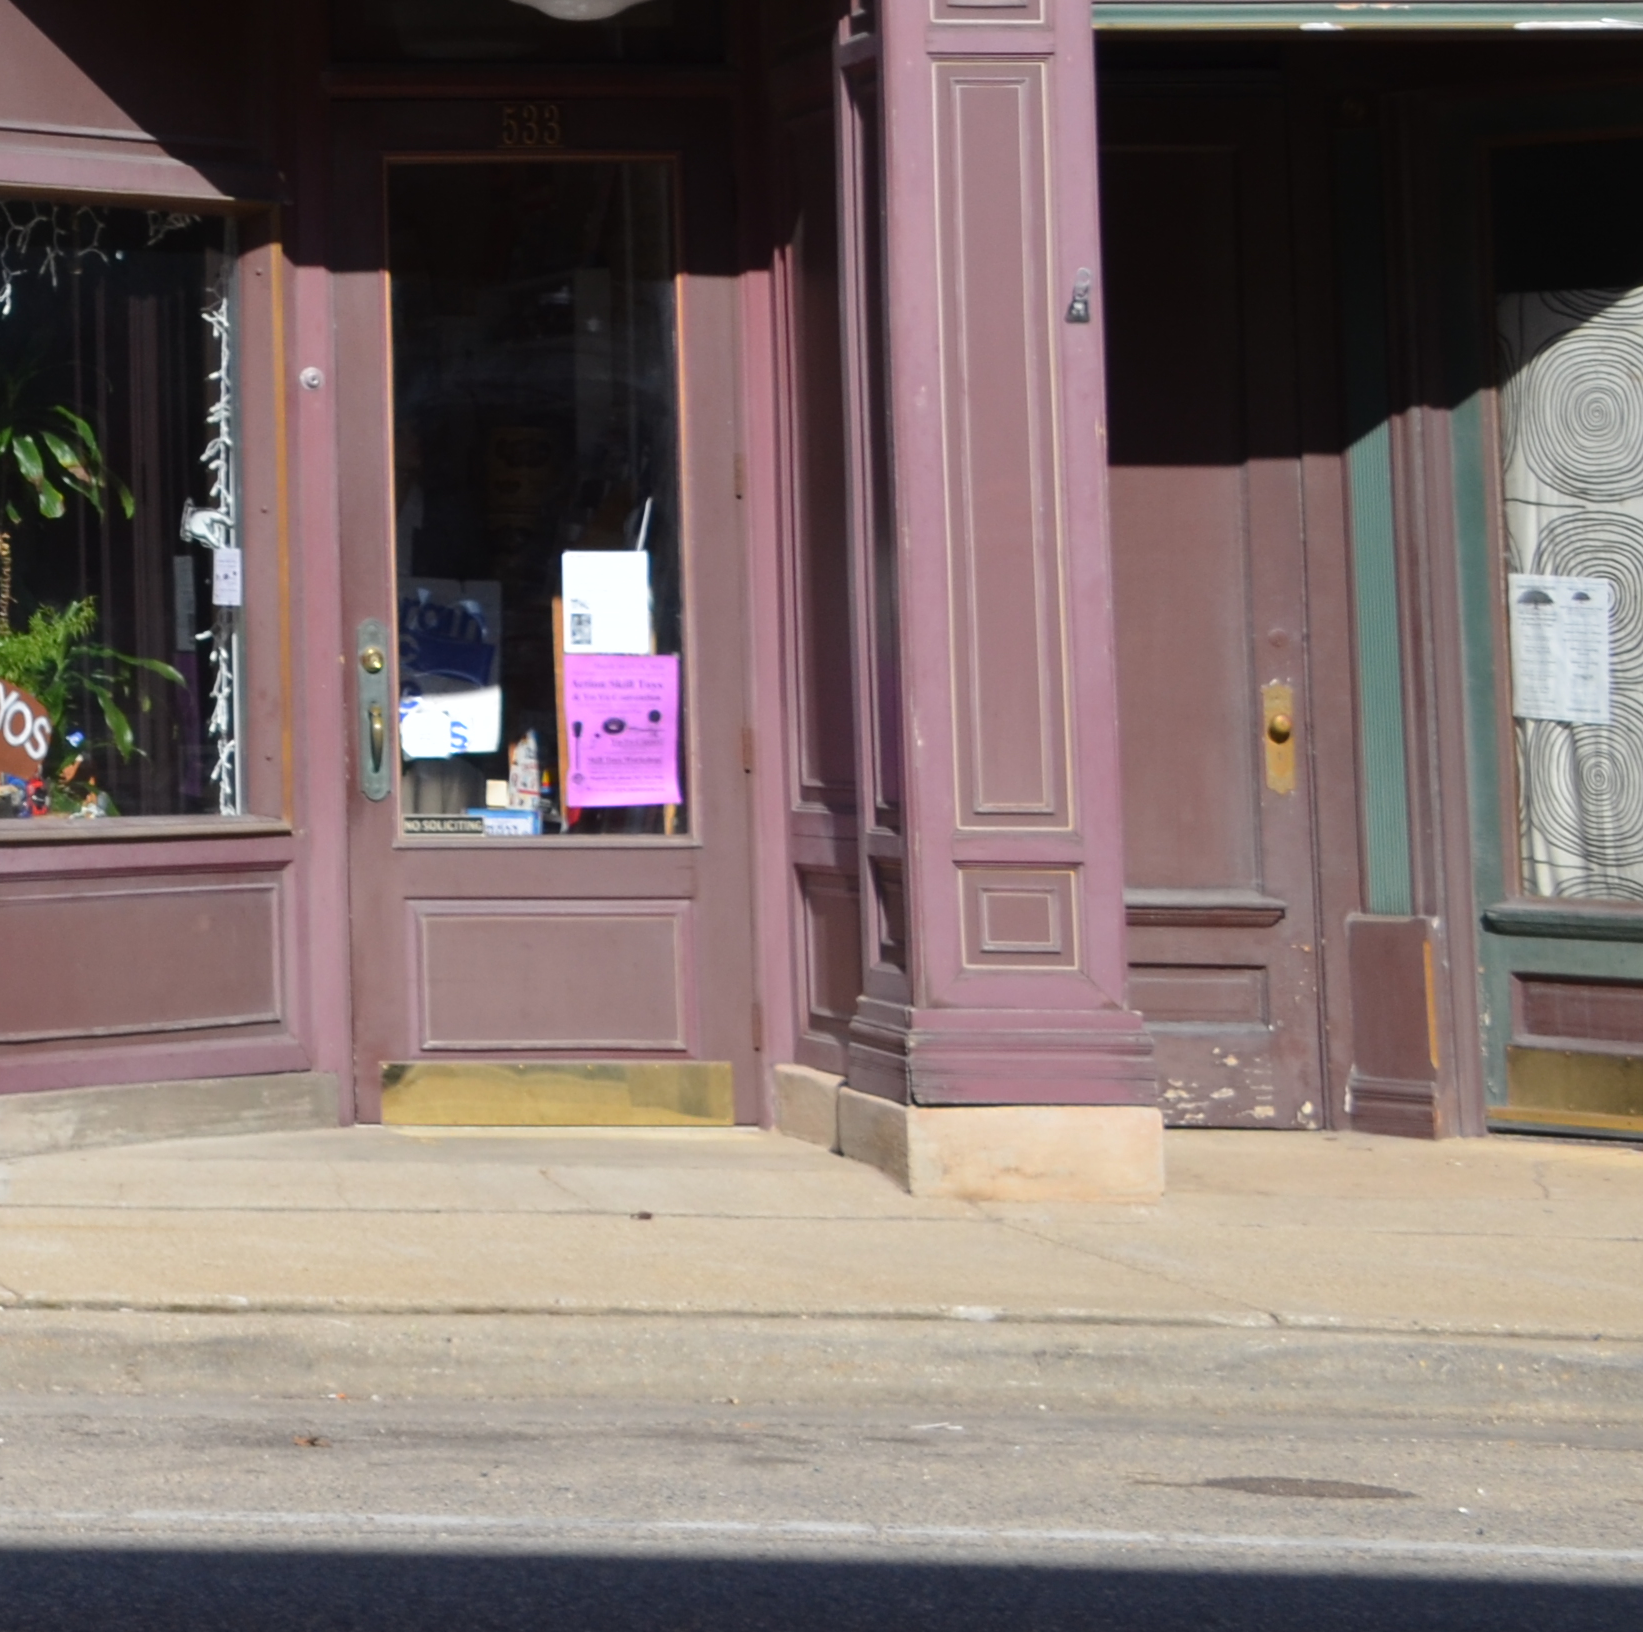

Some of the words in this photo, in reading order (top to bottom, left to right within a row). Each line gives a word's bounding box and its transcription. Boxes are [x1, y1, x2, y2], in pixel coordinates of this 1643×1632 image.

[502, 105, 561, 145] 533
[405, 818, 420, 834] NO
[422, 818, 483, 835] SOLICITING
